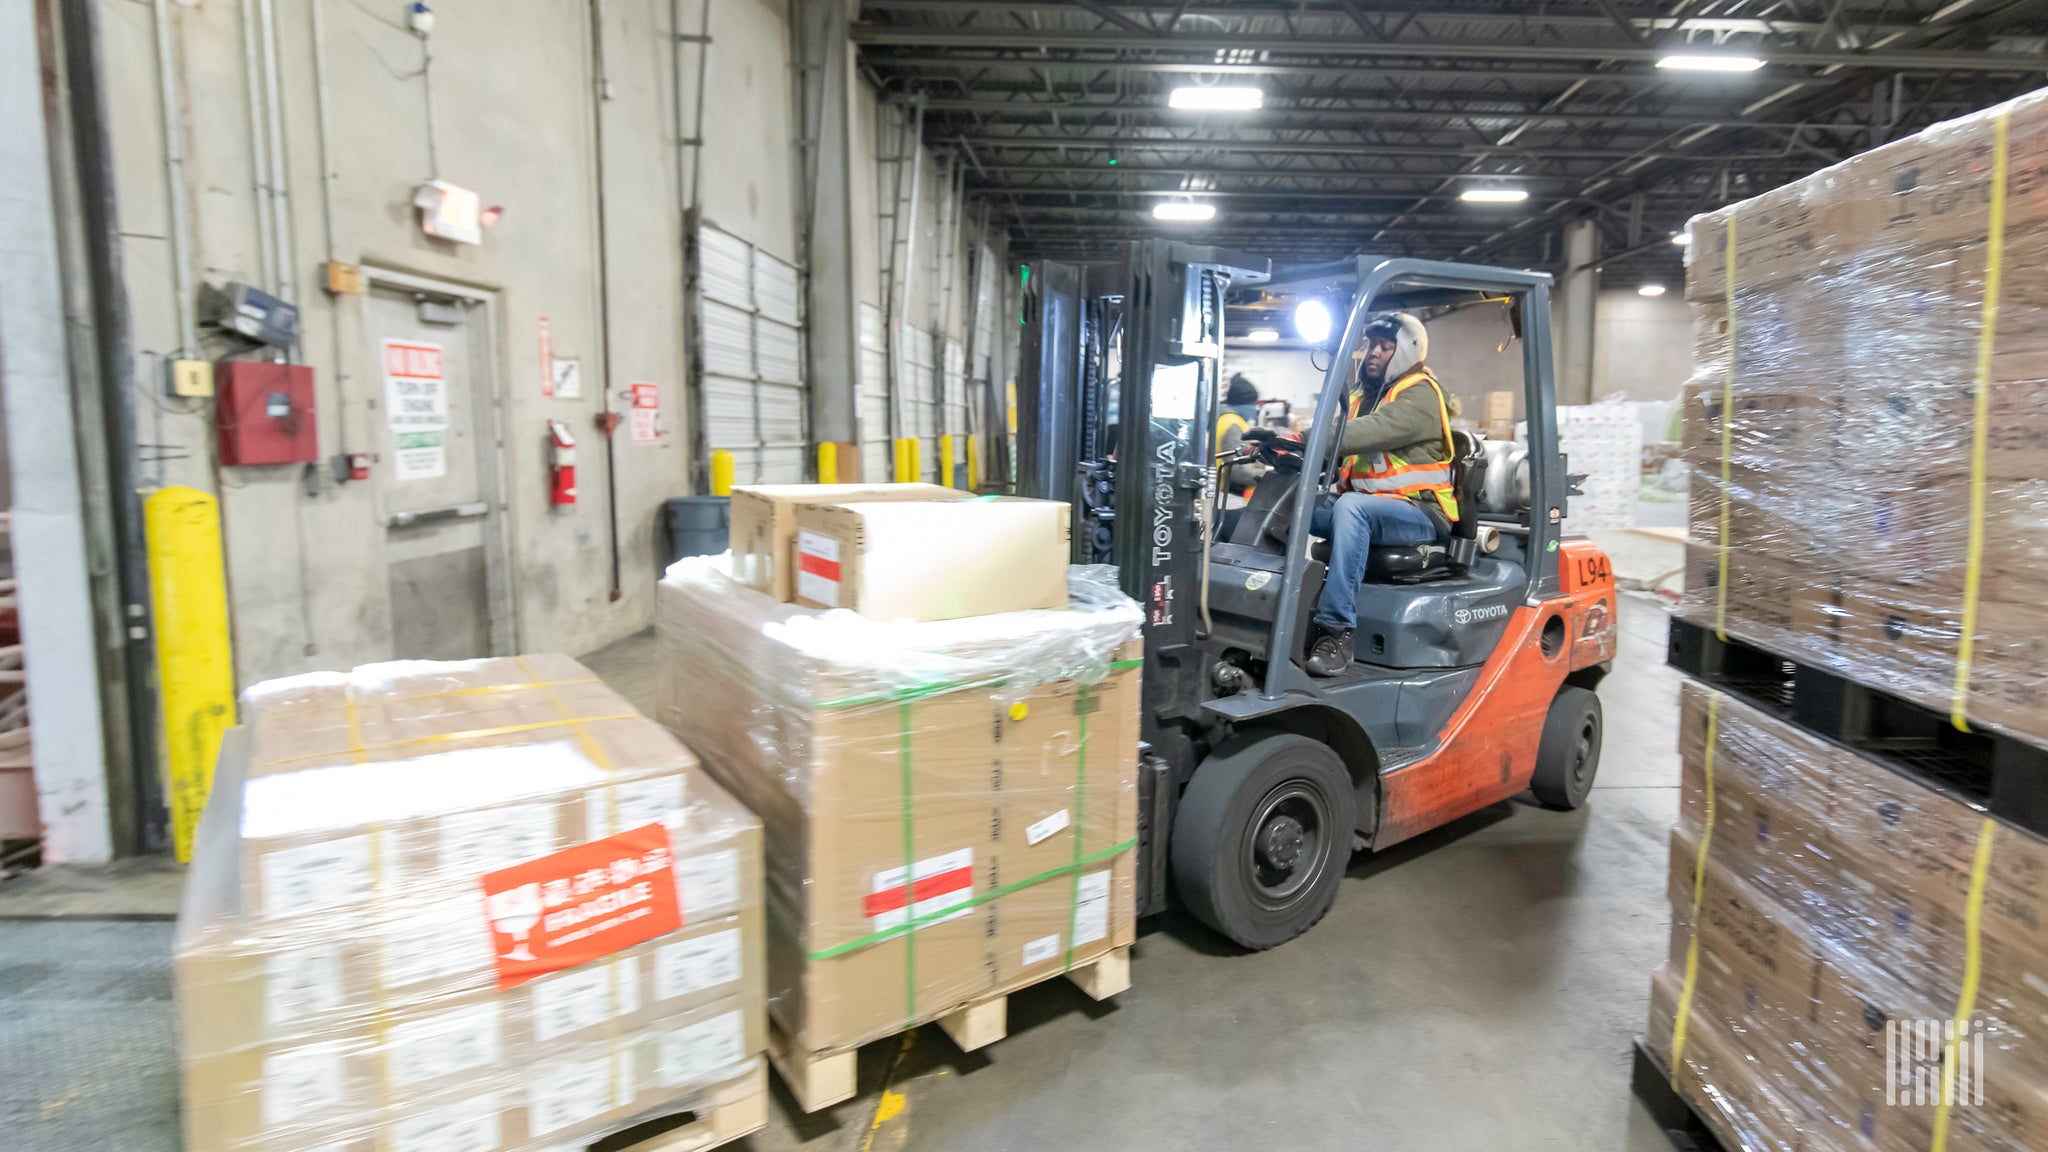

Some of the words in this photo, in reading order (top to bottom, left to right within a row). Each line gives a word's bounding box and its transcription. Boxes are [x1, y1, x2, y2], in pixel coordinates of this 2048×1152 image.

[1152, 440, 1177, 567] TOYOTA
[1578, 557, 1609, 586] L94
[1471, 604, 1508, 620] TOYOTA
